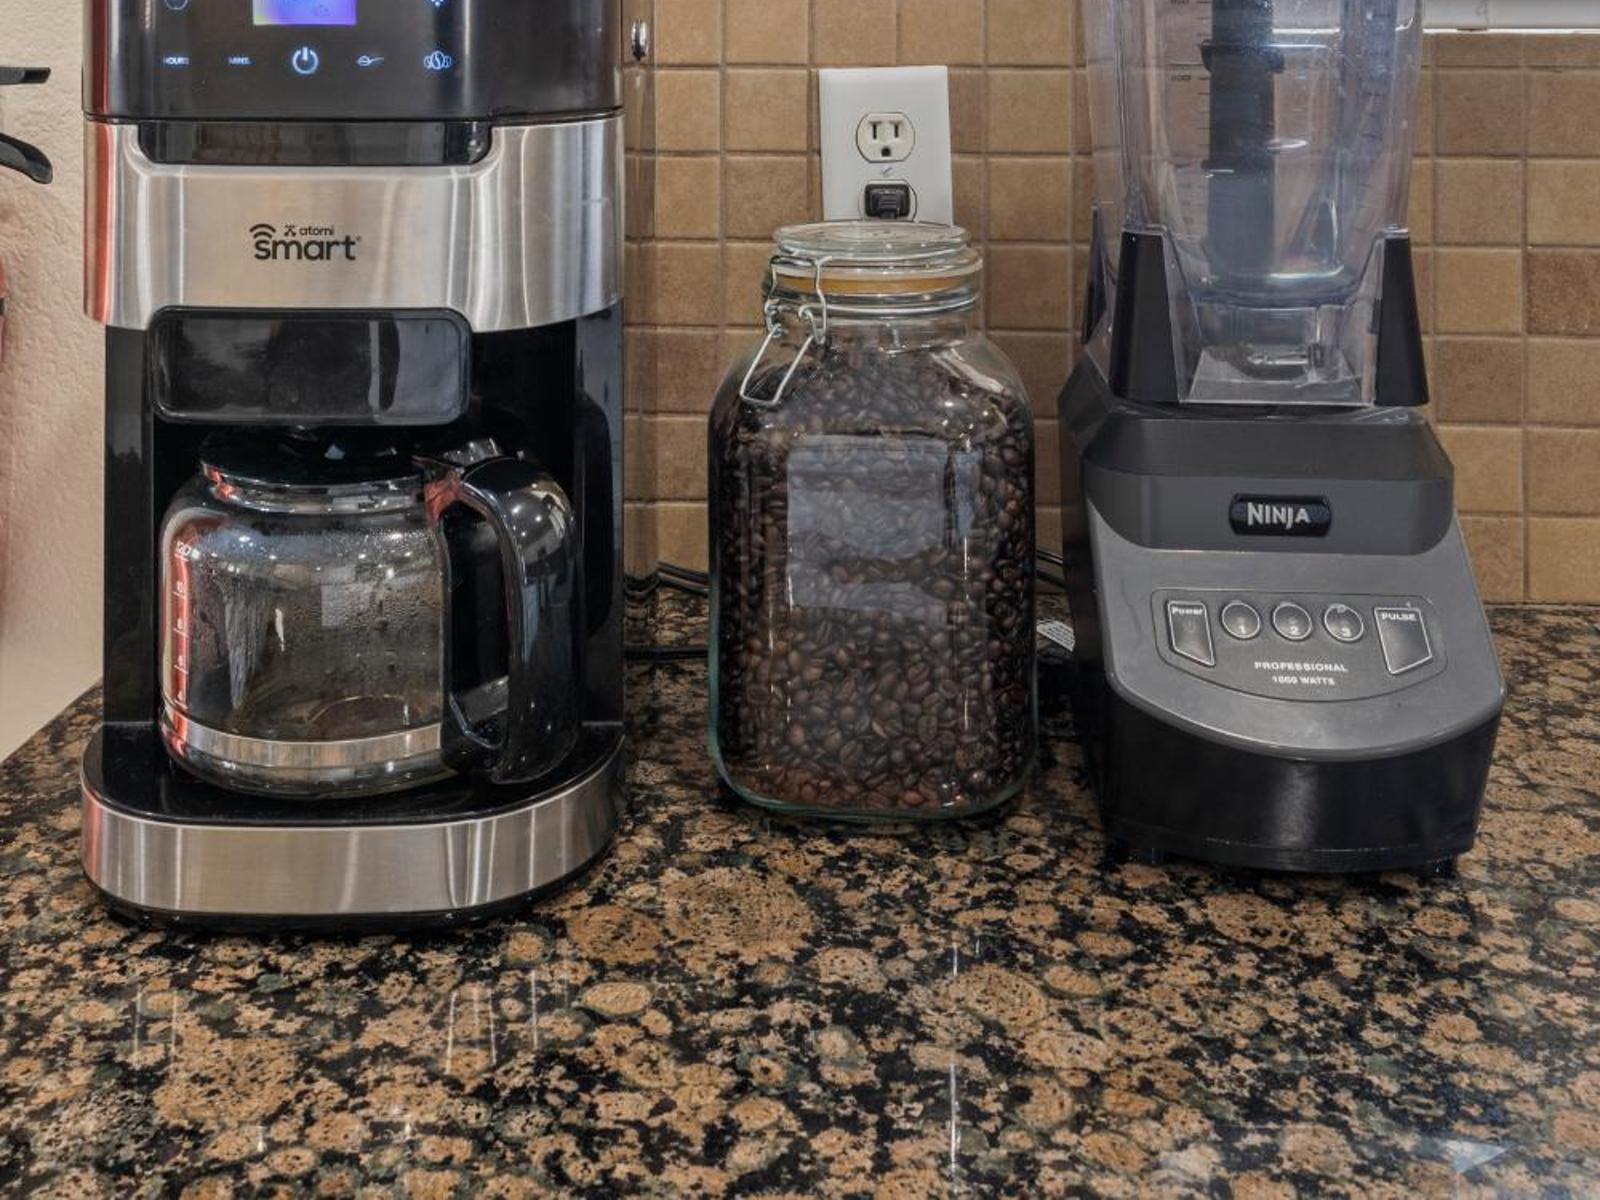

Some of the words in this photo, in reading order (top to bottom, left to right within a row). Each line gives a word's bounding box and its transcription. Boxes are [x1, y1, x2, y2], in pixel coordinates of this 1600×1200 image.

[299, 225, 335, 236] atomi
[254, 235, 357, 261] smart
[1247, 502, 1311, 530] NINJA
[1381, 612, 1417, 622] PULSE
[1290, 626, 1300, 636] 2
[1253, 661, 1349, 673] PROFESSIONAL
